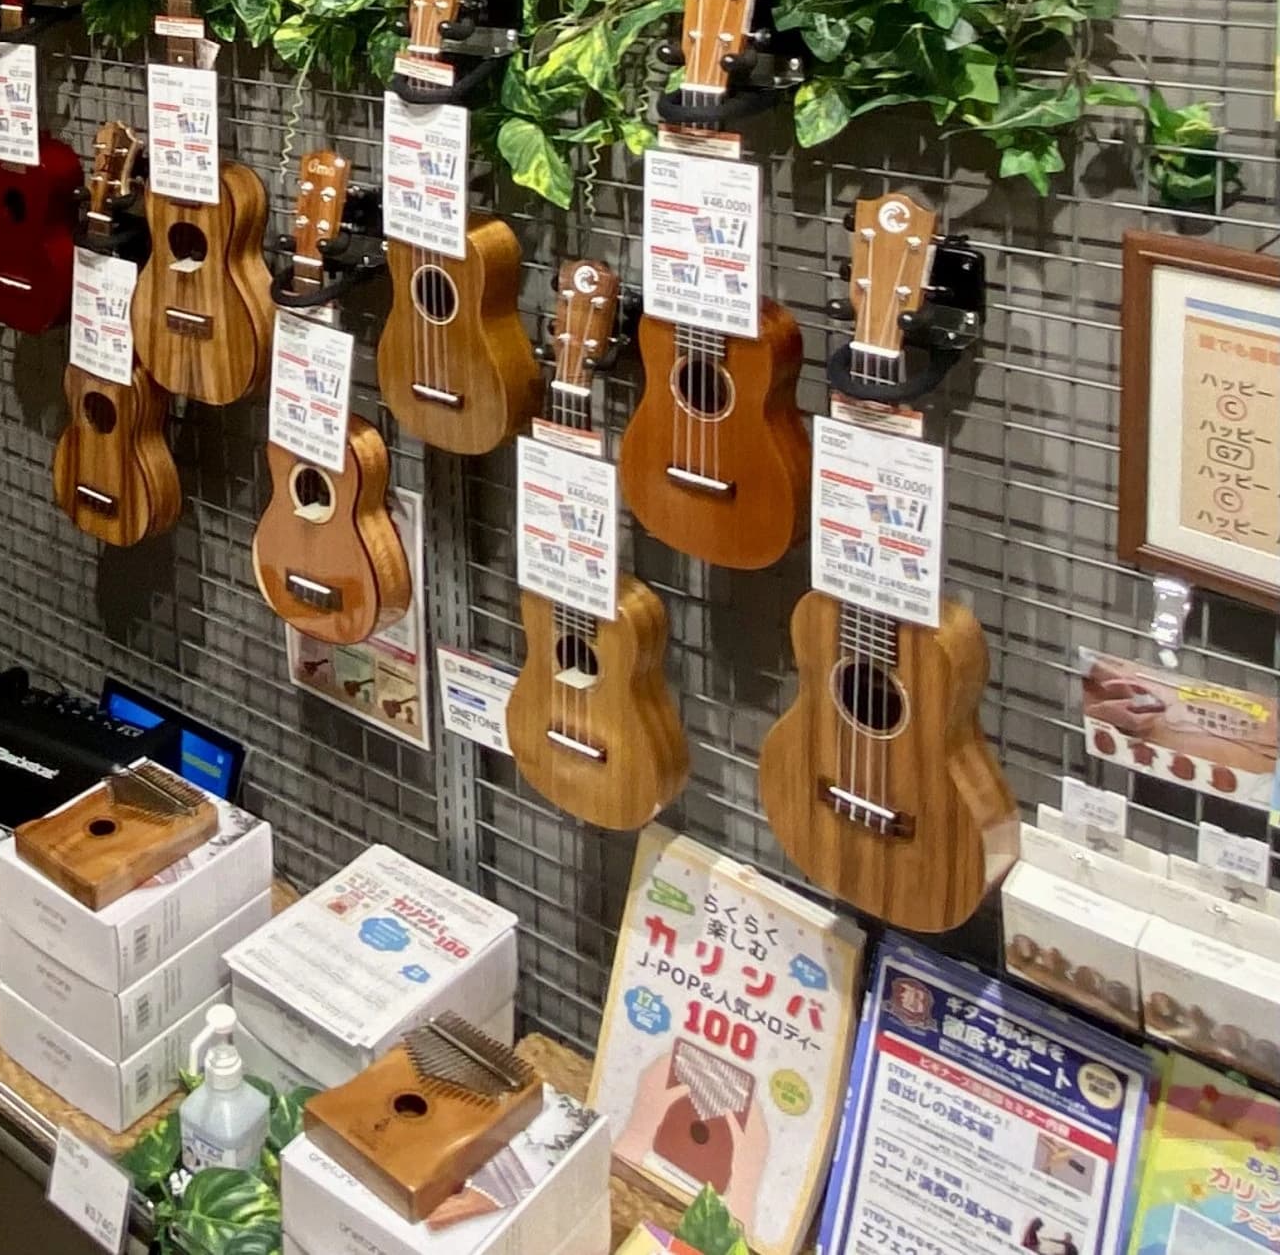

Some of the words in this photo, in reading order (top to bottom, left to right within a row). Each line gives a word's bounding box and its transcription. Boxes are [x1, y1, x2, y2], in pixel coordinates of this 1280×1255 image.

[1201, 373, 1275, 398] ハッピー
[1200, 419, 1272, 444] ハッピー
[1215, 444, 1242, 461] G7
[1198, 465, 1271, 491] ハッピー
[1197, 510, 1270, 536] ハッピー
[703, 893, 780, 946] らくらく
[434, 932, 470, 959] 100
[707, 918, 768, 962] 楽しむ
[645, 915, 826, 1032] カリンバ
[683, 1000, 758, 1060] 100
[942, 1014, 1072, 1089] 徹底サポート
